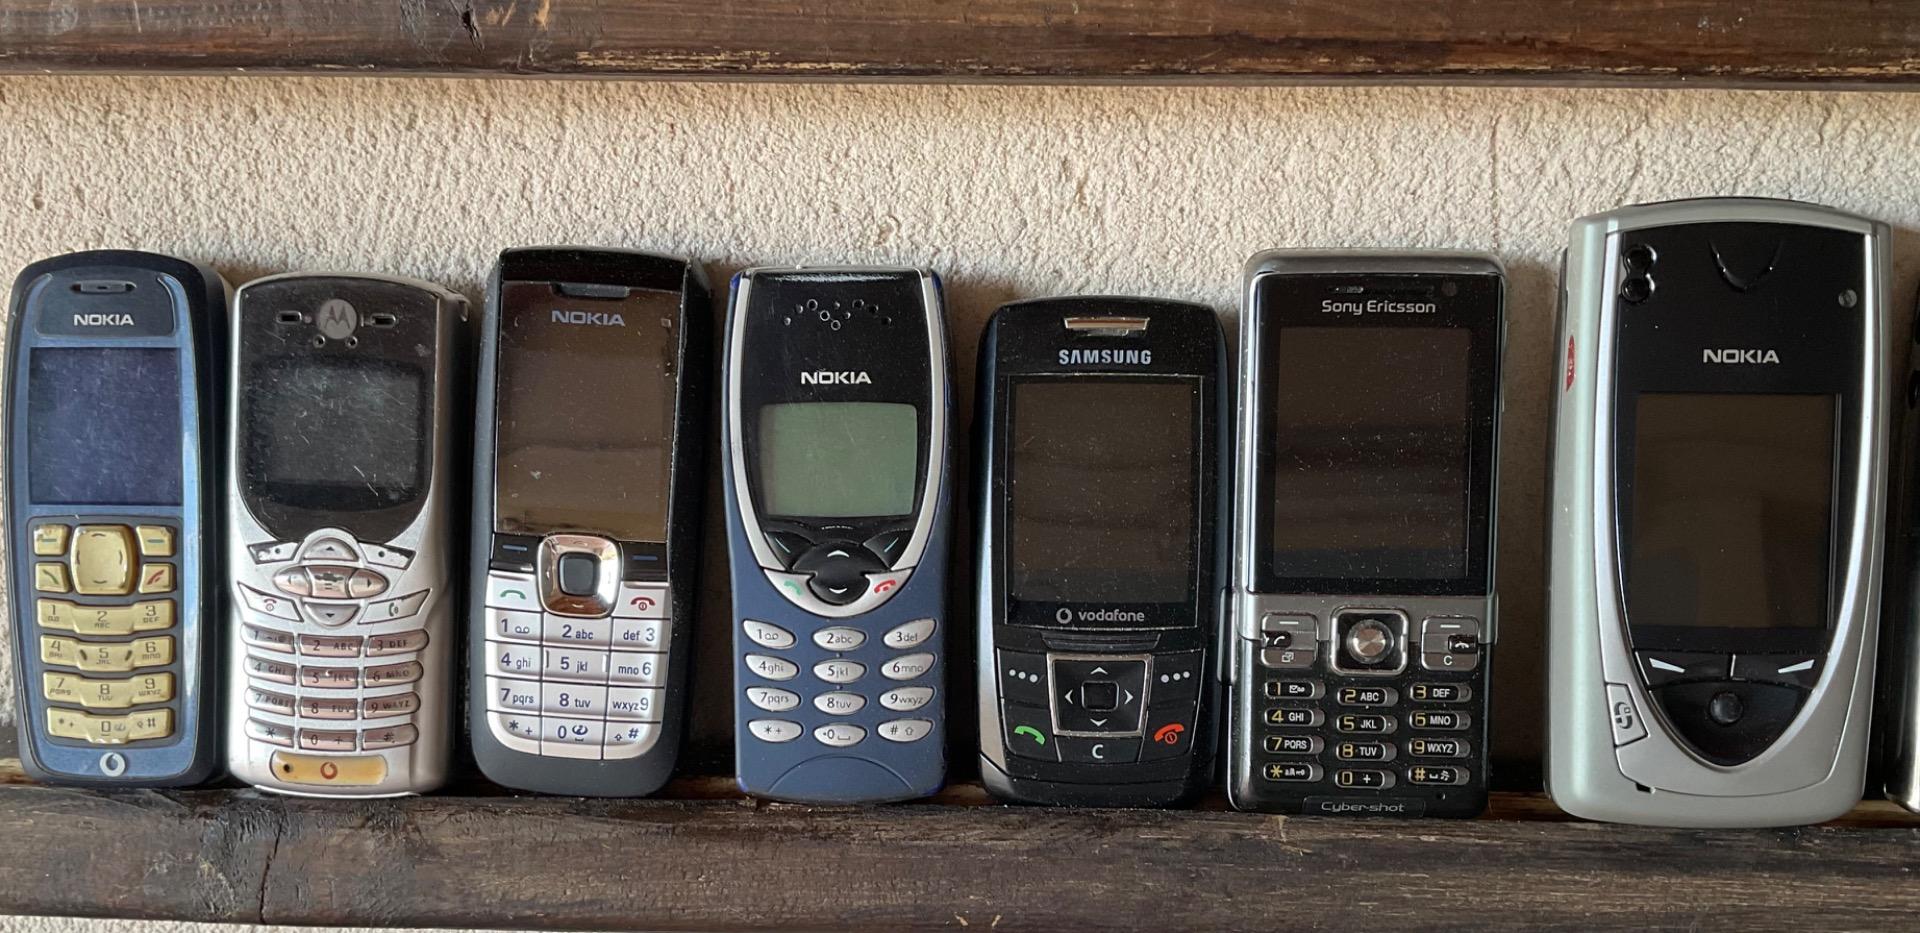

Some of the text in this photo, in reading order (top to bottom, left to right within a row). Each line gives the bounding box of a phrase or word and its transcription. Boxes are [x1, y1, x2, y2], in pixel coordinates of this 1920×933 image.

[1321, 299, 1436, 315] Sony Ericsson
[73, 313, 135, 326] NOKIA
[551, 309, 626, 327] NOKIA
[1058, 349, 1152, 366] SAMSUNG
[1702, 349, 1780, 365] NOKIA
[801, 370, 872, 385] NOKIA
[97, 610, 108, 622] 2
[145, 605, 156, 617] 3
[1078, 609, 1145, 622] vodafone
[501, 618, 508, 633] 1
[562, 625, 594, 640] 2 abc
[623, 628, 656, 642] def 3
[51, 640, 61, 652] 4
[145, 641, 156, 653] 6
[313, 640, 321, 651] 2
[376, 640, 383, 651] 3
[98, 648, 109, 659] 5
[501, 652, 532, 670] 4 ghi
[560, 657, 588, 674] 5 jkl
[1443, 655, 1453, 666] C
[618, 662, 651, 676] mno 6
[56, 677, 65, 688] 7
[312, 672, 320, 683] 5
[373, 670, 381, 682] 6
[100, 684, 110, 695] 8
[145, 678, 155, 689] 9
[1274, 681, 1281, 696] 1
[501, 688, 534, 705] 7 pqrs
[1344, 689, 1380, 703] 2 ABC
[1416, 685, 1450, 698] 3 DEF
[559, 693, 591, 708] 8 tuv
[311, 702, 319, 714] 8
[371, 703, 378, 713] 9
[1271, 710, 1304, 723] 4 GHI
[1415, 712, 1451, 726] 6 MNO
[1343, 717, 1377, 731] 5 JKL
[557, 726, 567, 739] 0
[310, 734, 318, 745] 0
[1271, 737, 1307, 750] 7 PQRS
[1092, 744, 1104, 759] C
[1342, 743, 1377, 758] 8 TUV
[1414, 740, 1453, 754] 9 WXYZ
[1342, 771, 1353, 785] 0
